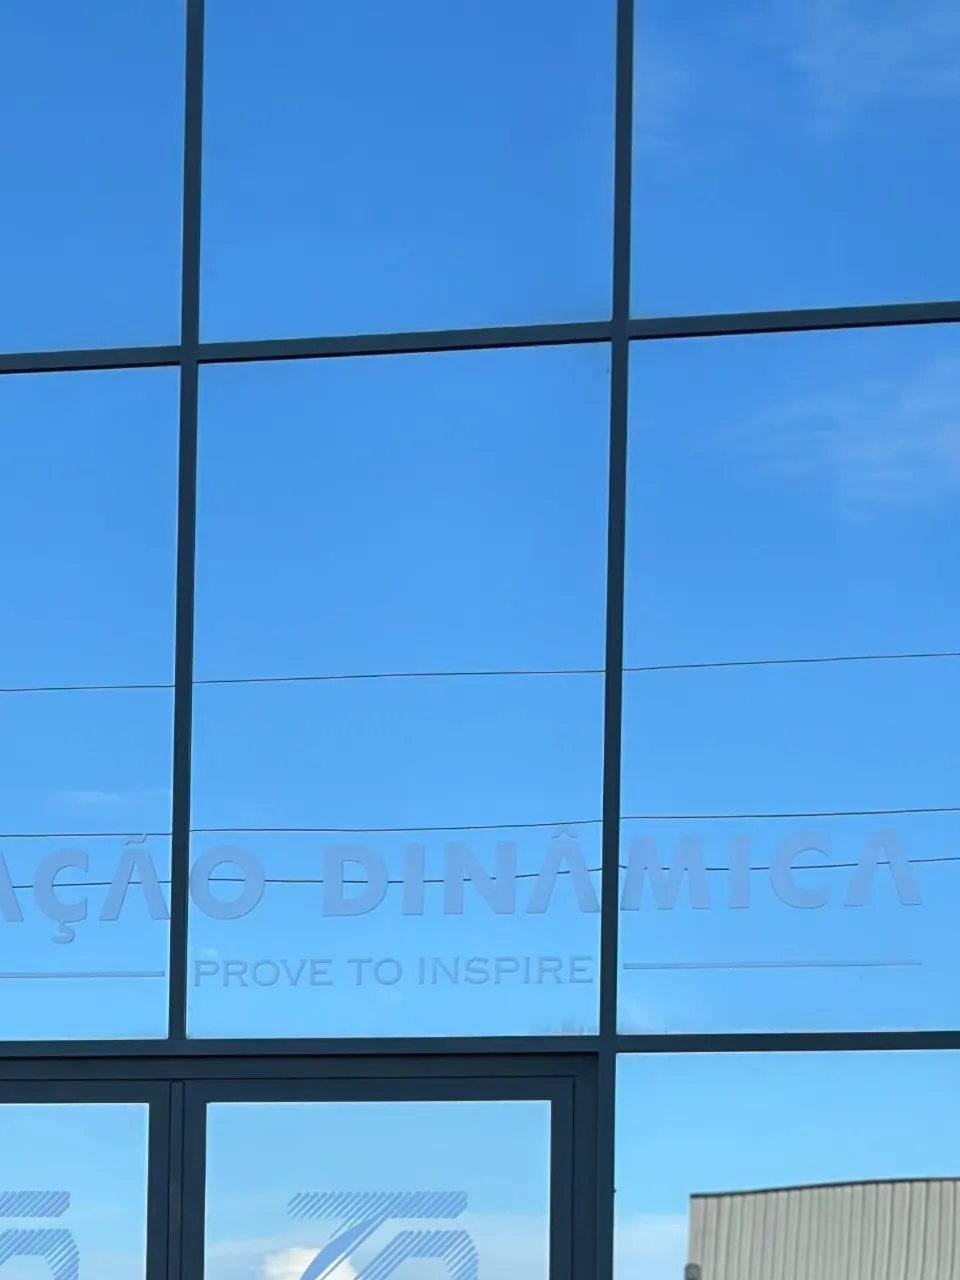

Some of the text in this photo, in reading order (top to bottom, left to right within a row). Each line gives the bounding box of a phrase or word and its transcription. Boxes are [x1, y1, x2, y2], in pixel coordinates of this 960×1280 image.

[321, 828, 923, 918] DINÂMICA
[192, 955, 594, 987] PROVE TO INSPIRE
